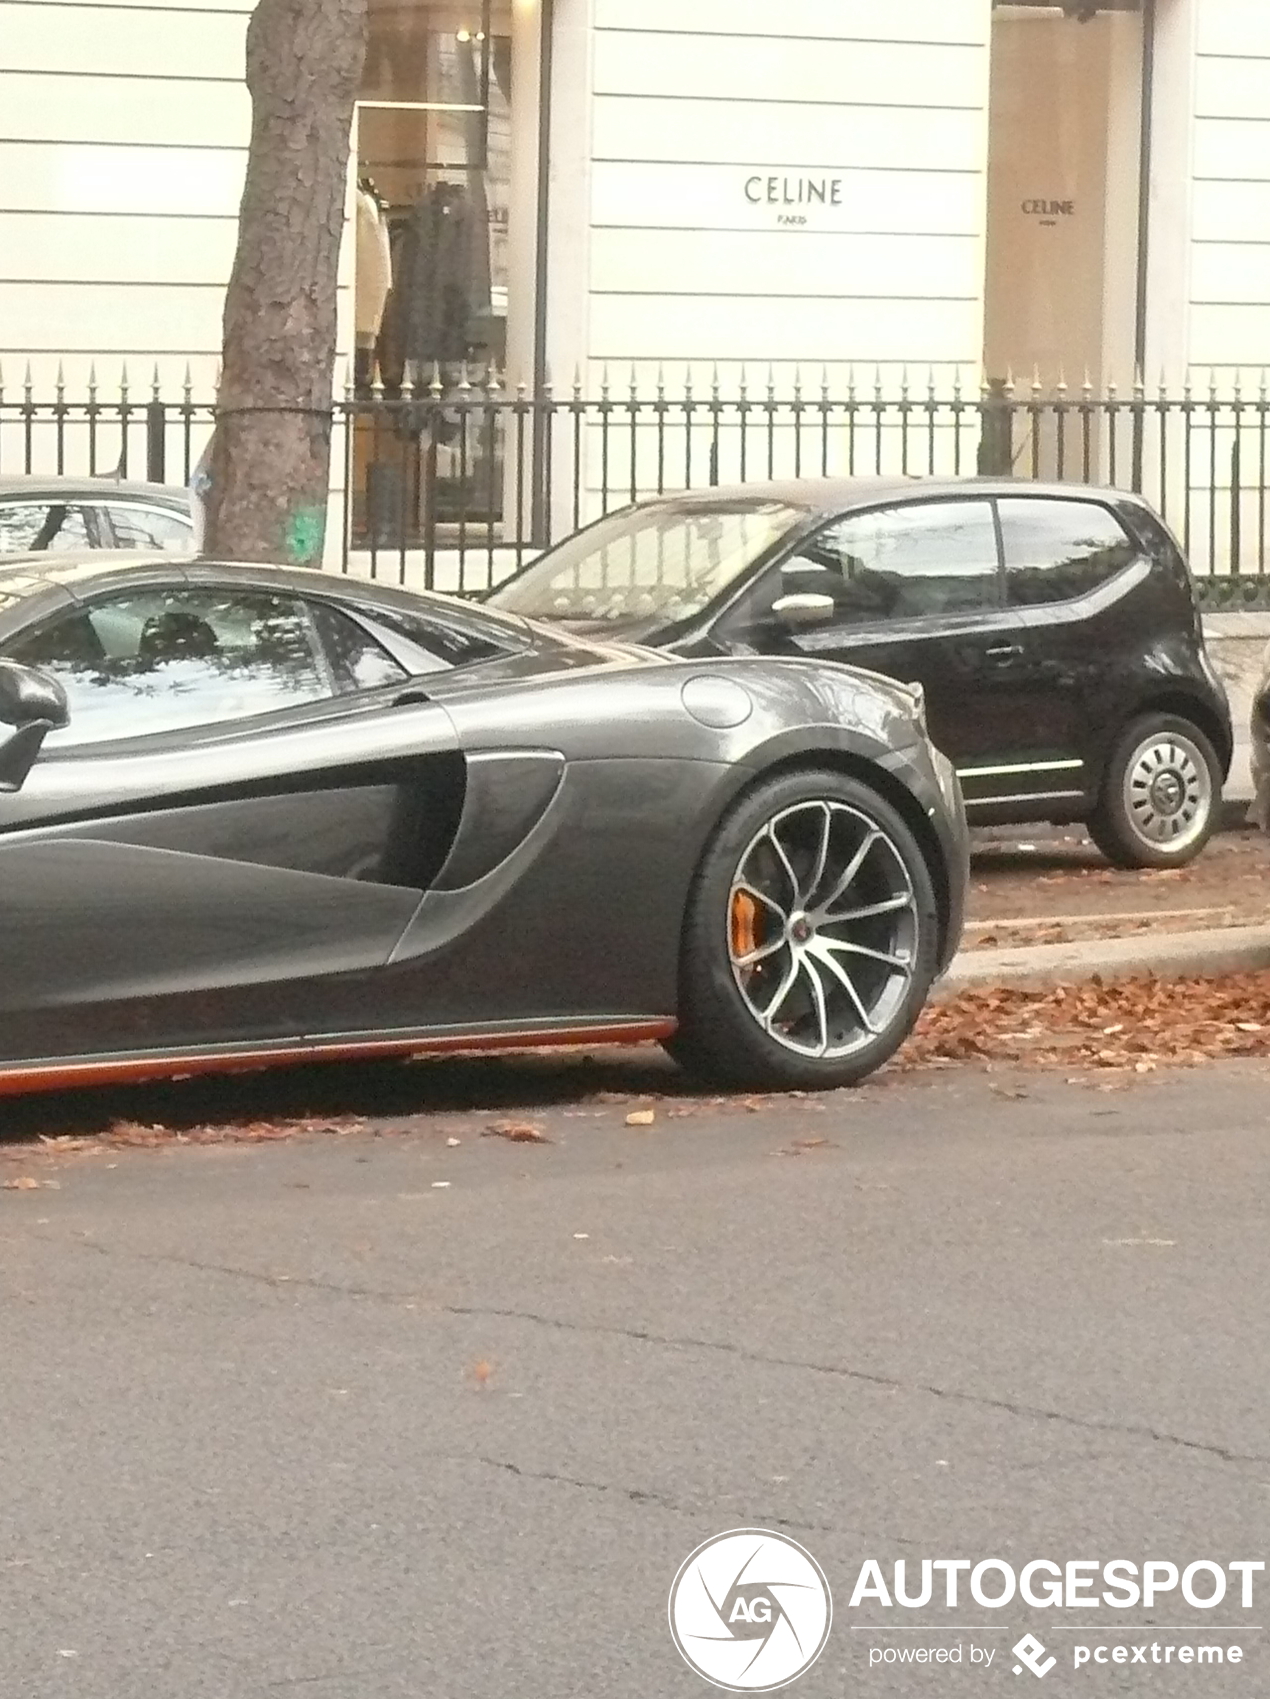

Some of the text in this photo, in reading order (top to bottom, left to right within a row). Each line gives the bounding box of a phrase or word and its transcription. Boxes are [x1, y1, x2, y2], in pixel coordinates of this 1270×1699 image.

[744, 176, 843, 205] CELINE
[1021, 199, 1074, 215] CELINE
[777, 214, 807, 225] PARIS
